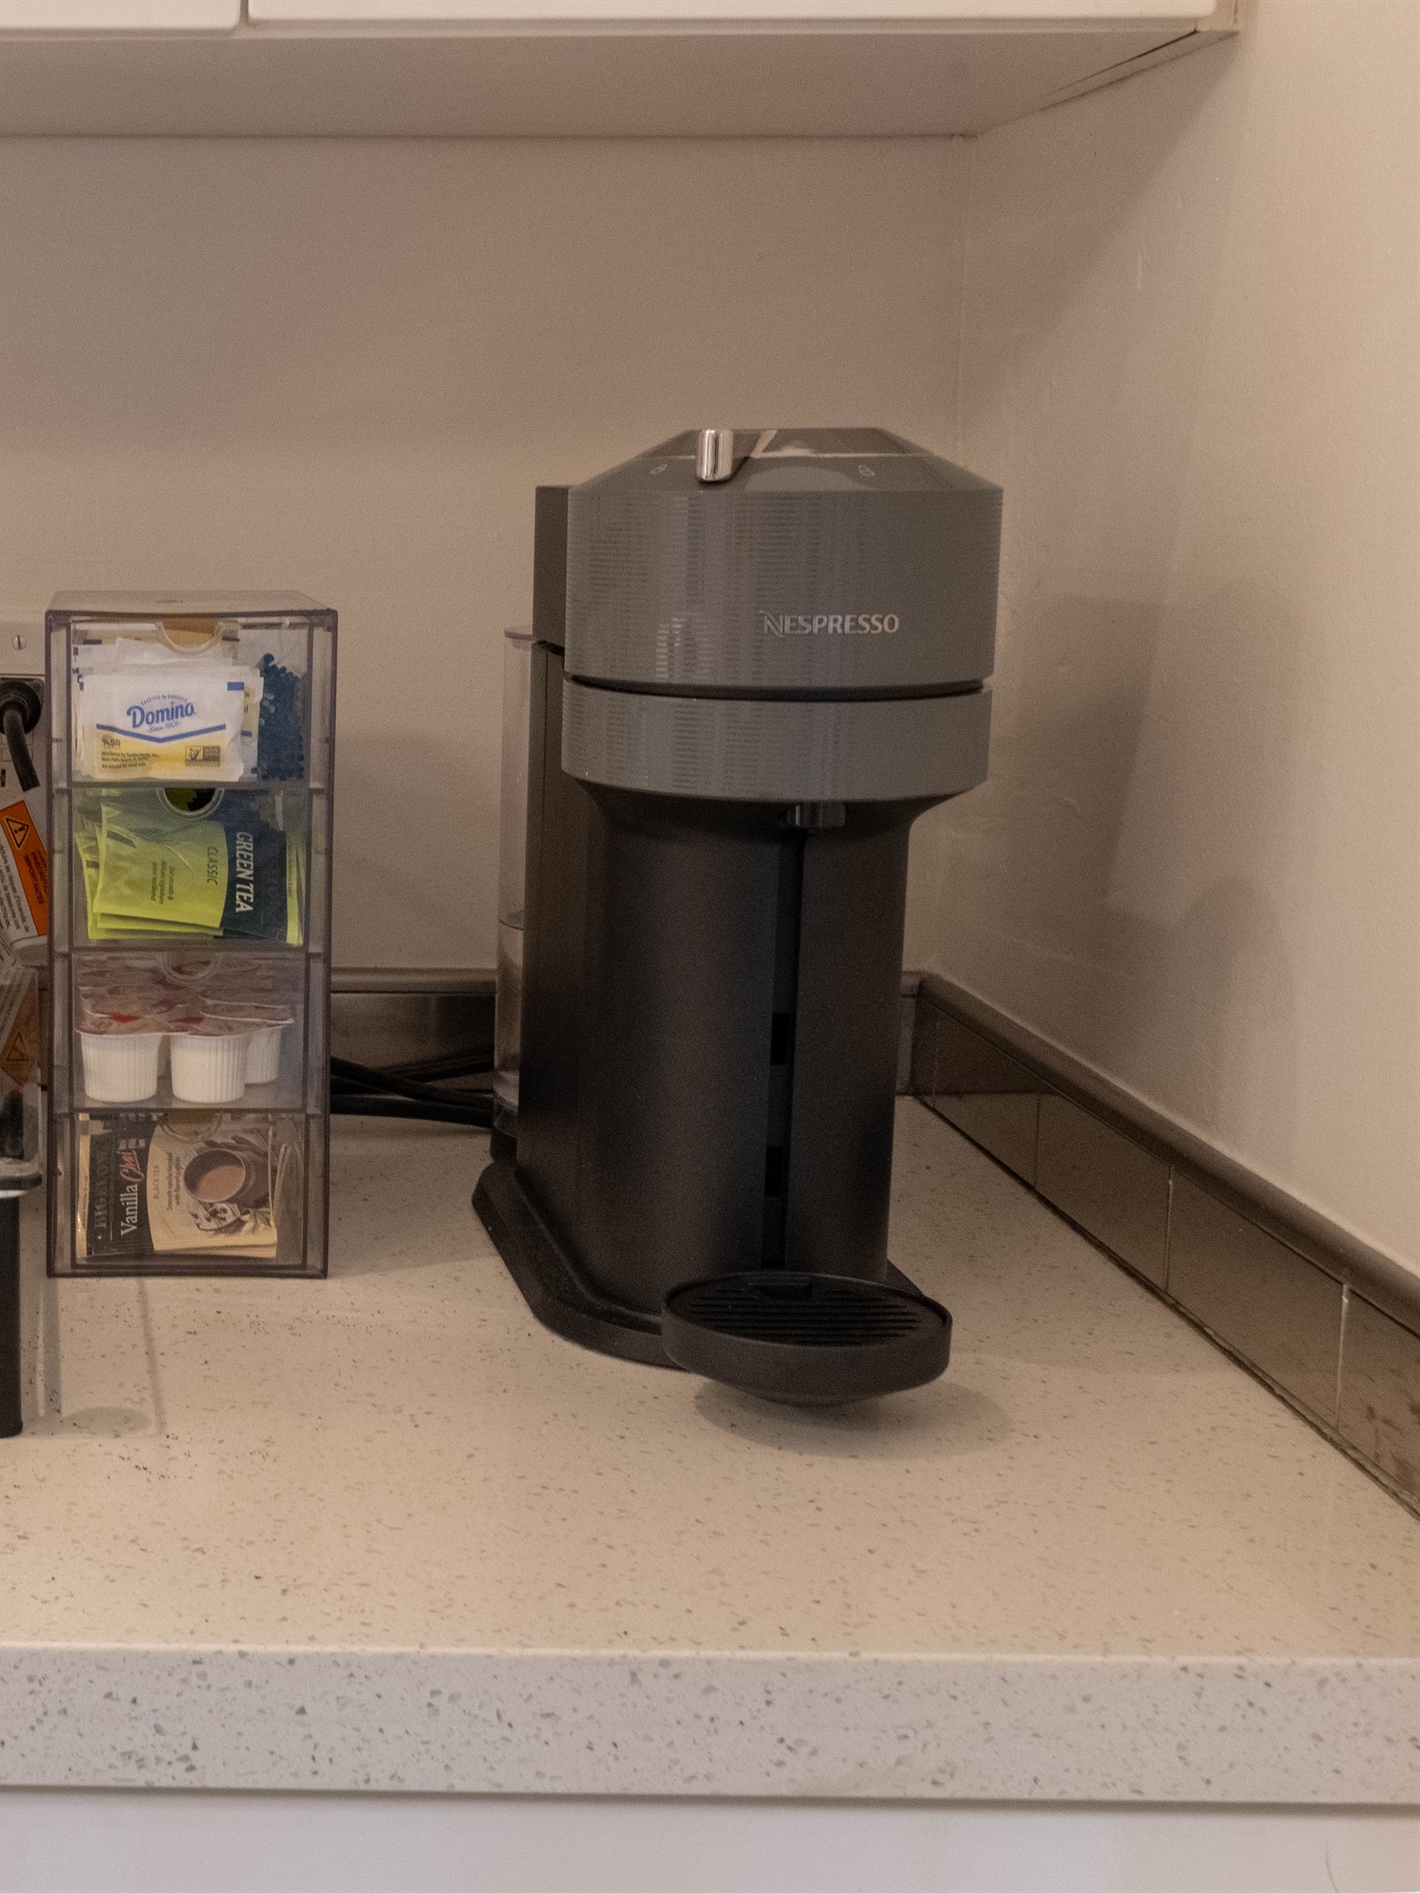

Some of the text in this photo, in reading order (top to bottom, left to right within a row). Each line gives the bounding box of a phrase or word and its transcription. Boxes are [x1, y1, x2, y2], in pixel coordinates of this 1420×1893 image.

[760, 610, 900, 639] NESPRESSO
[127, 701, 196, 728] Domino
[24, 853, 44, 904] IMPORTANTES
[206, 846, 218, 886] CLASSIC
[235, 832, 254, 913] GREEN TEA
[117, 1149, 145, 1183] Chai
[120, 1184, 138, 1236] Vanilla
